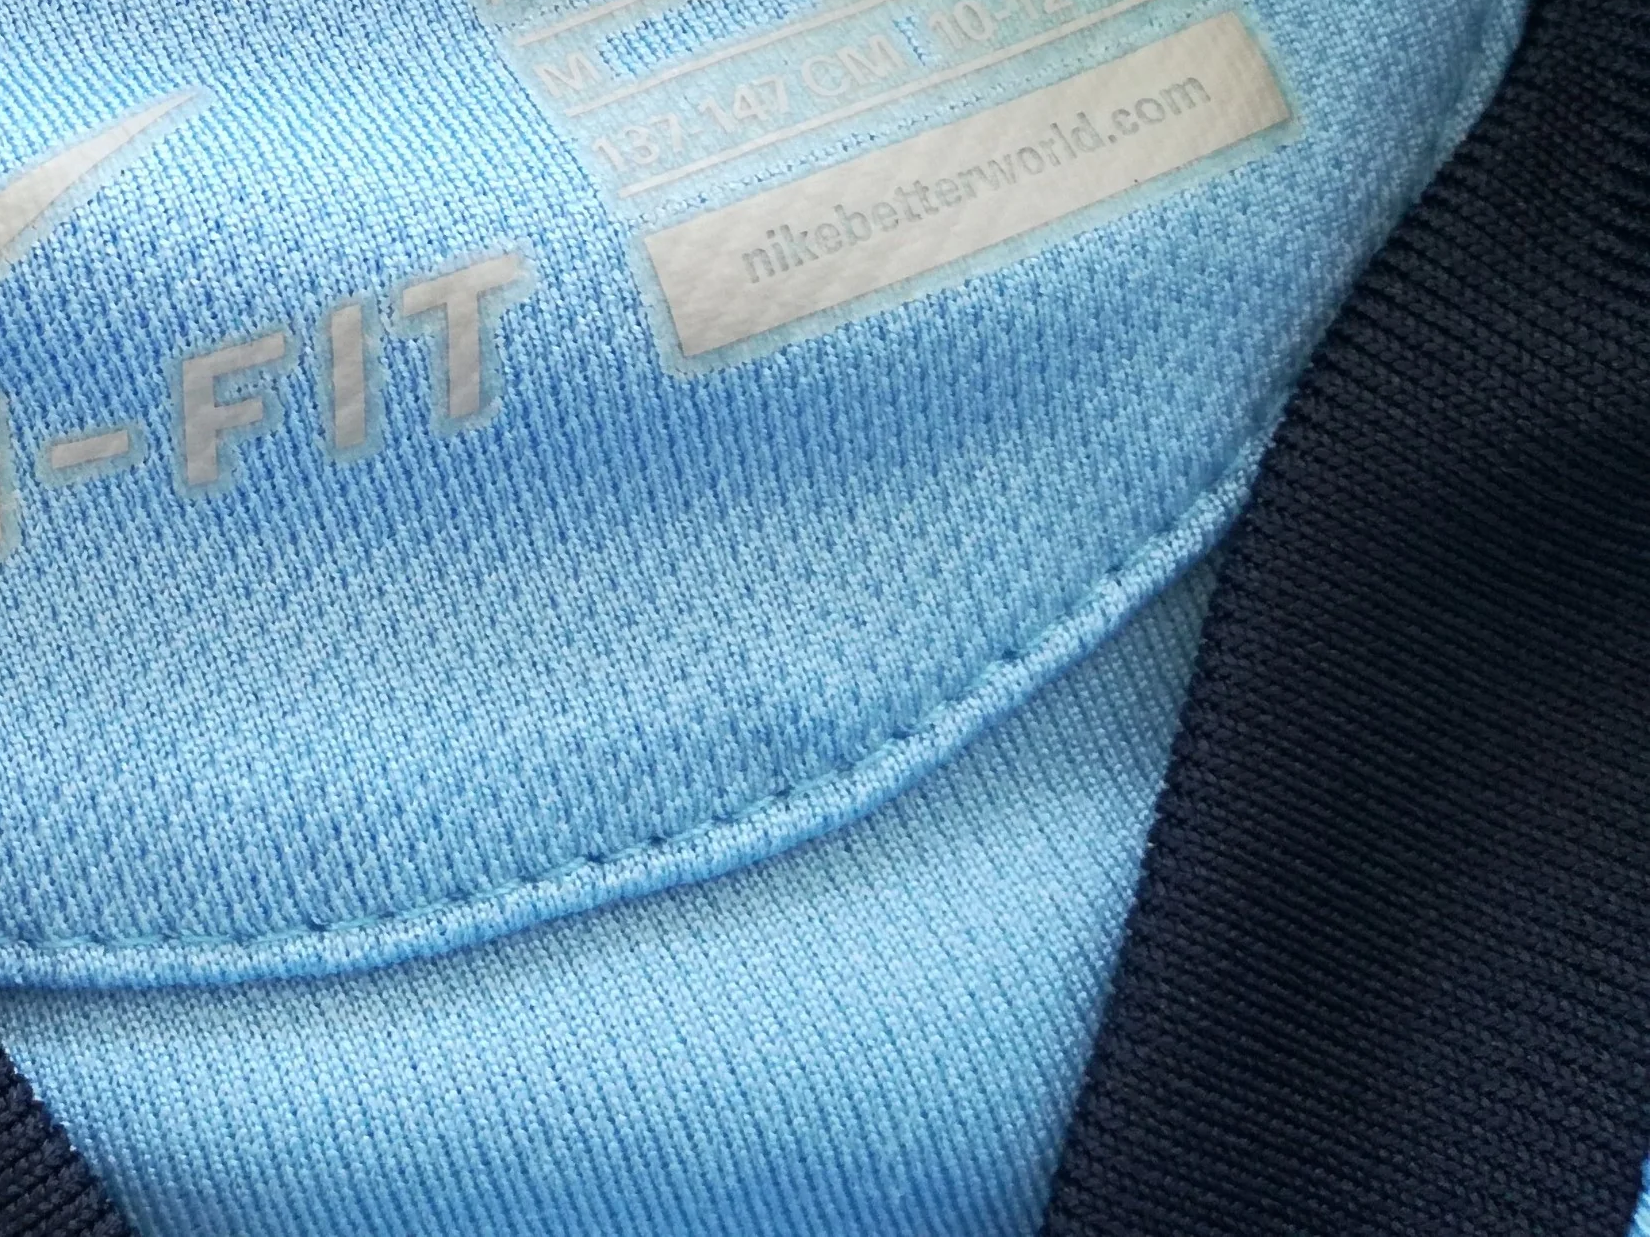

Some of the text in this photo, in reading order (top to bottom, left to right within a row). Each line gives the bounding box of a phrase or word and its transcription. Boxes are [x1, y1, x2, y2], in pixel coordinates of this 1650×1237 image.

[534, 49, 600, 99] M
[592, 73, 791, 173] 137-147
[802, 33, 908, 98] CM
[740, 75, 1213, 285] nikebetterworld.com
